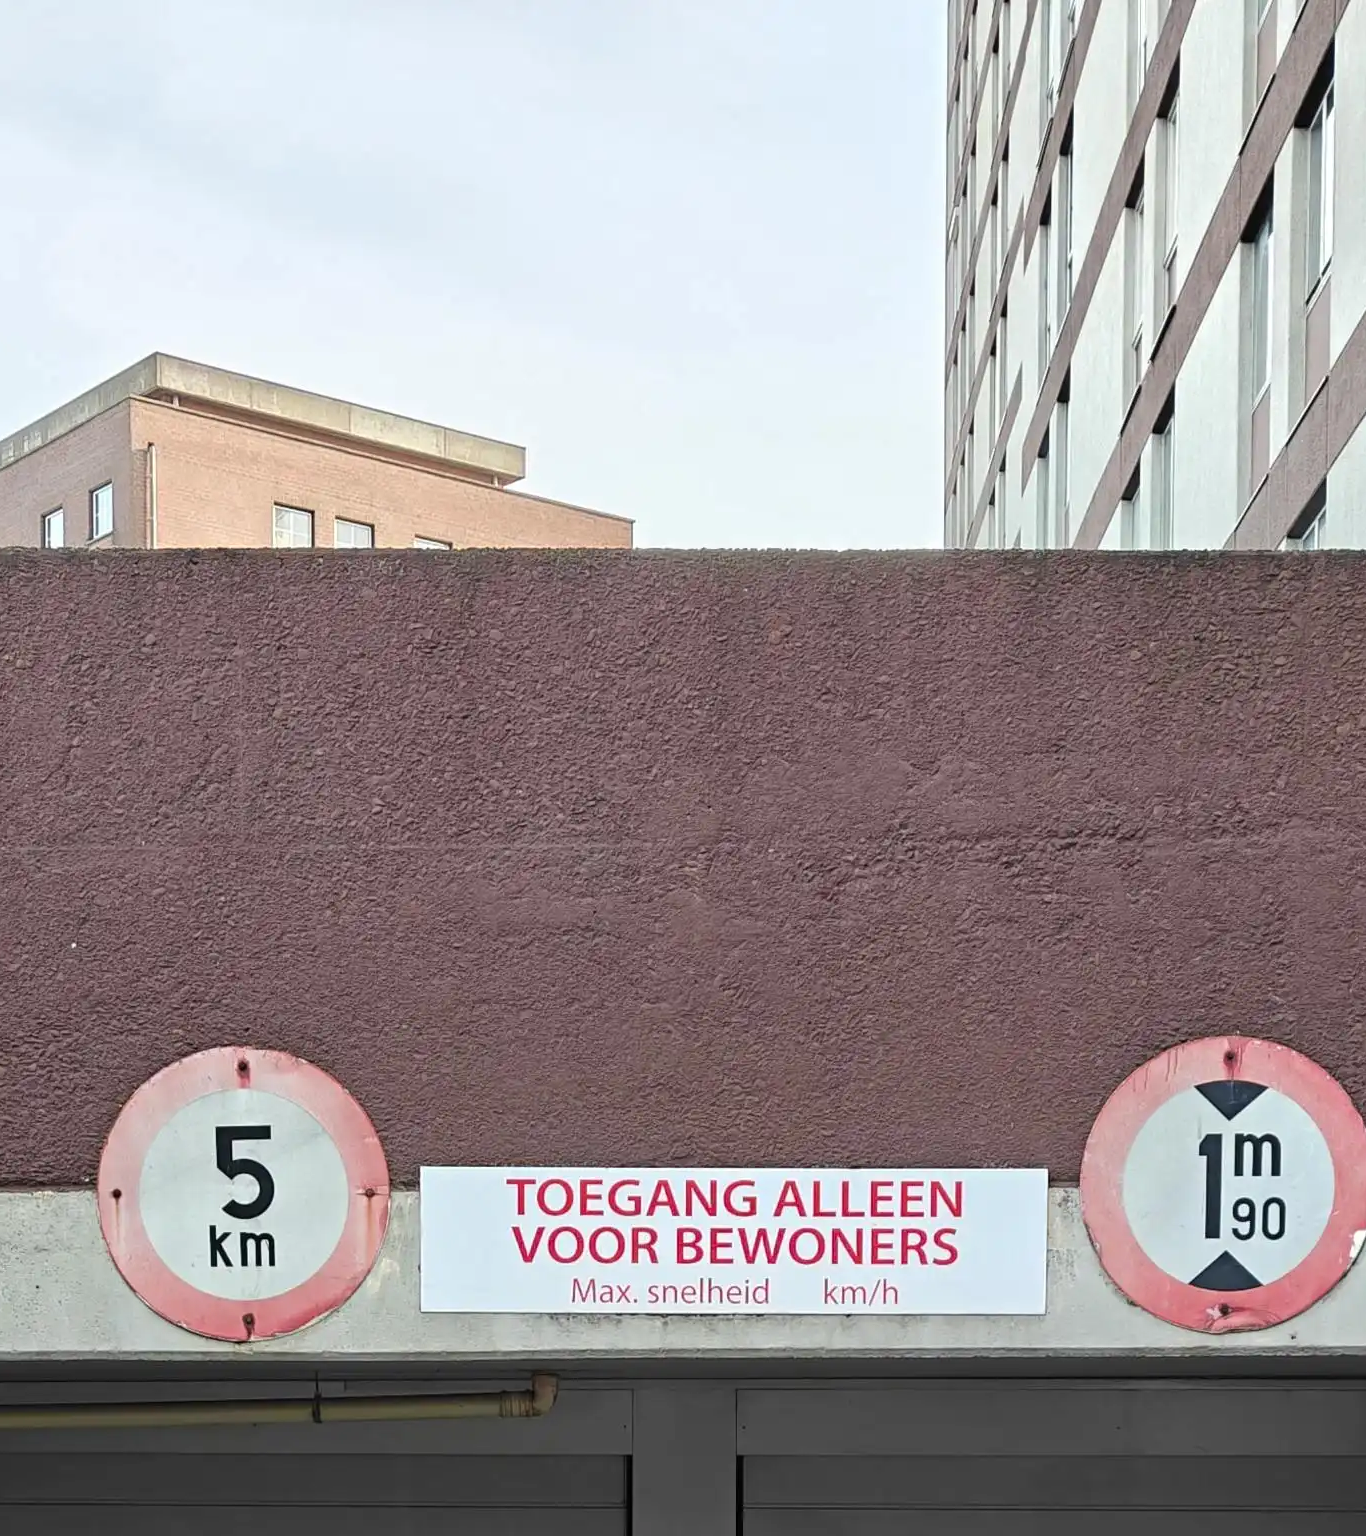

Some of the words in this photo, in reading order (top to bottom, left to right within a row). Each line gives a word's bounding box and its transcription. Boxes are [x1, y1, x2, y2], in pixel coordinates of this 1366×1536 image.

[214, 1124, 274, 1219] 5
[506, 1179, 757, 1217] TOEGANG
[773, 1180, 963, 1217] ALLEEN
[1231, 1196, 1286, 1240] 90
[209, 1224, 275, 1267] km
[511, 1226, 658, 1264] VOOR
[676, 1227, 958, 1265] BEWONERS
[572, 1278, 638, 1304] Max.
[648, 1277, 769, 1305] snelheid
[824, 1277, 899, 1306] km/h
